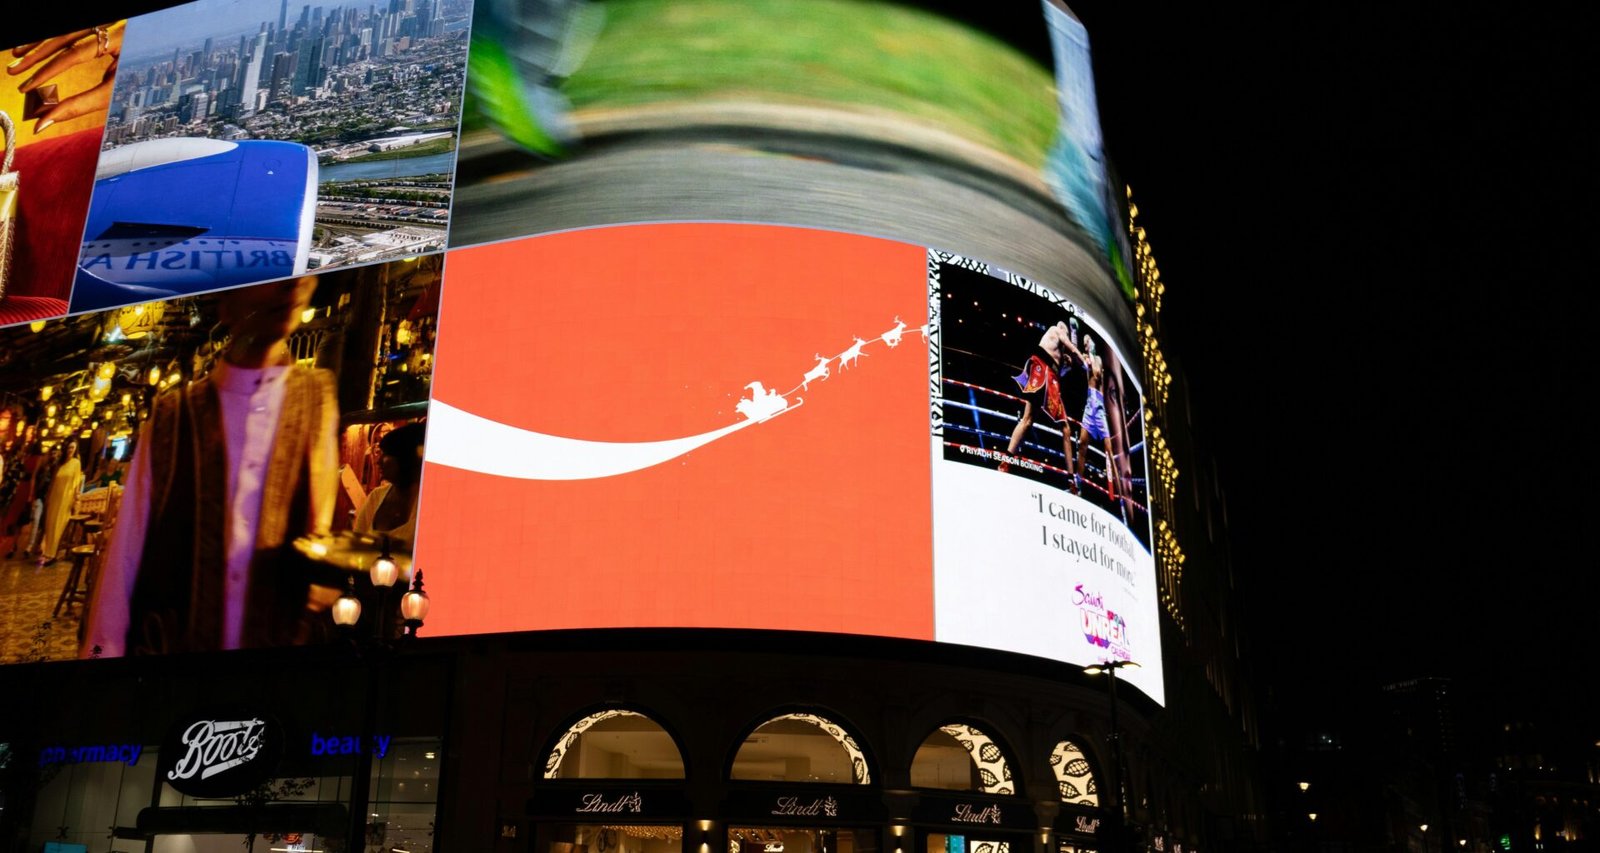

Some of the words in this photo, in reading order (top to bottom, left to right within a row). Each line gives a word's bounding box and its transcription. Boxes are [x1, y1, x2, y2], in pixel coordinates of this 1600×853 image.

[966, 446, 992, 459] RIYADH
[993, 451, 1019, 465] SEASON
[1020, 460, 1044, 473] BOXING
[1048, 502, 1088, 529] came
[1091, 512, 1107, 538] for
[1042, 525, 1047, 546] I
[1052, 533, 1097, 563] stayed
[1100, 545, 1114, 572] for
[168, 718, 265, 780] Boots
[311, 731, 391, 761] beay
[576, 793, 630, 813] Lindt
[771, 796, 823, 816] Lindt
[951, 803, 992, 824] Lindt
[1074, 815, 1096, 834] Lindt
